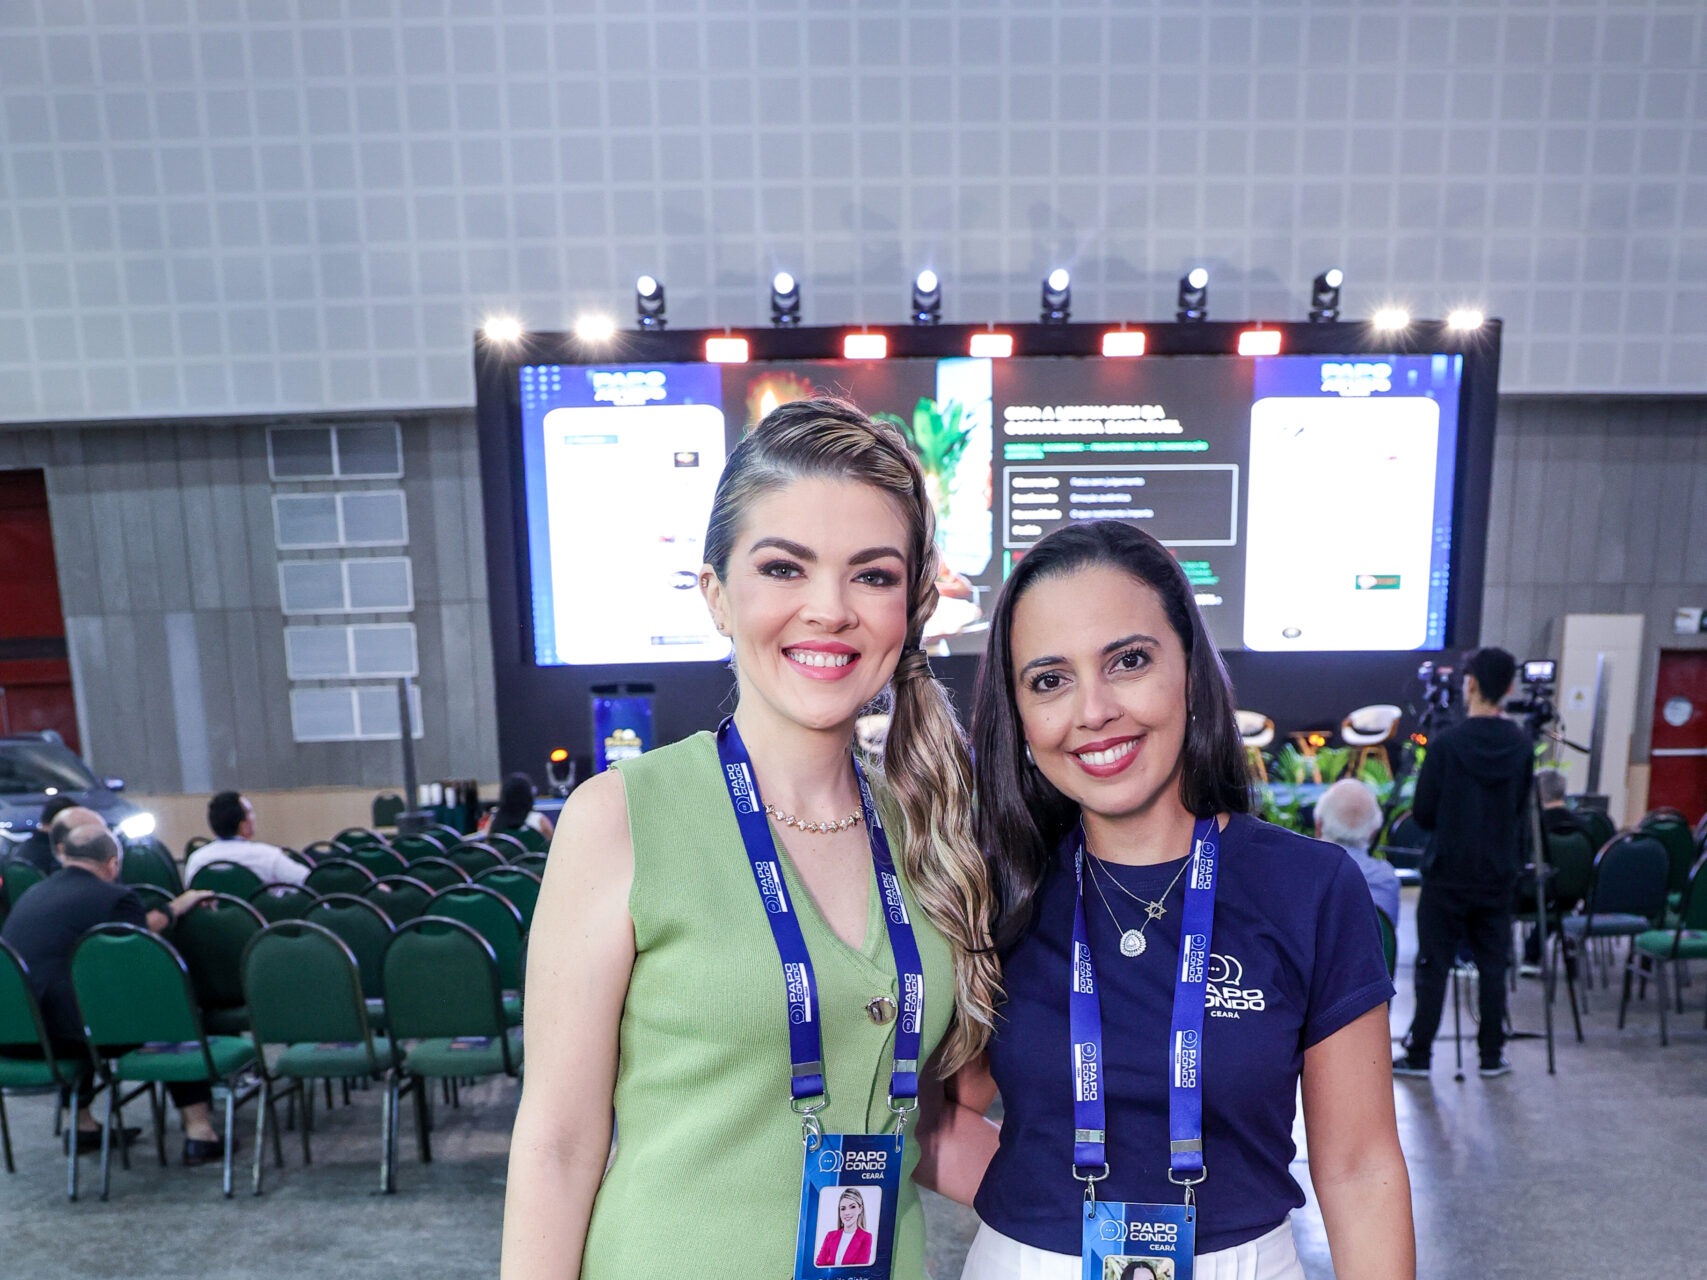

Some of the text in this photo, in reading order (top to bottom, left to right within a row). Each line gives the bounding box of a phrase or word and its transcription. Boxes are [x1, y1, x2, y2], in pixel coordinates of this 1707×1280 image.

[726, 764, 742, 796] PAPO
[734, 763, 748, 795] CONDO
[755, 861, 770, 895] PAPO
[762, 861, 776, 895] CONDO
[881, 871, 893, 905] PAPO
[1198, 858, 1206, 890] CONDO
[1204, 859, 1213, 890] PAPO
[785, 963, 798, 1003] PAPO
[792, 962, 804, 1002] CONDO
[1085, 962, 1094, 994] PAPO
[1188, 951, 1197, 983] CONDO
[1195, 951, 1205, 983] PAPO
[904, 973, 912, 1012] PAPO
[1205, 995, 1266, 1012] ONDO
[1206, 982, 1264, 1000] APO
[1210, 1010, 1241, 1020] CEARÁ
[1089, 1062, 1098, 1101] PAPO
[1188, 1049, 1197, 1088] PAPO
[845, 1161, 887, 1171] CONDO
[846, 1151, 888, 1162] PAPO
[861, 1171, 884, 1180] CEARÁ
[1130, 1222, 1178, 1234] PAPO
[1130, 1232, 1178, 1243] CONDO
[1149, 1243, 1176, 1252] CEARÁ
